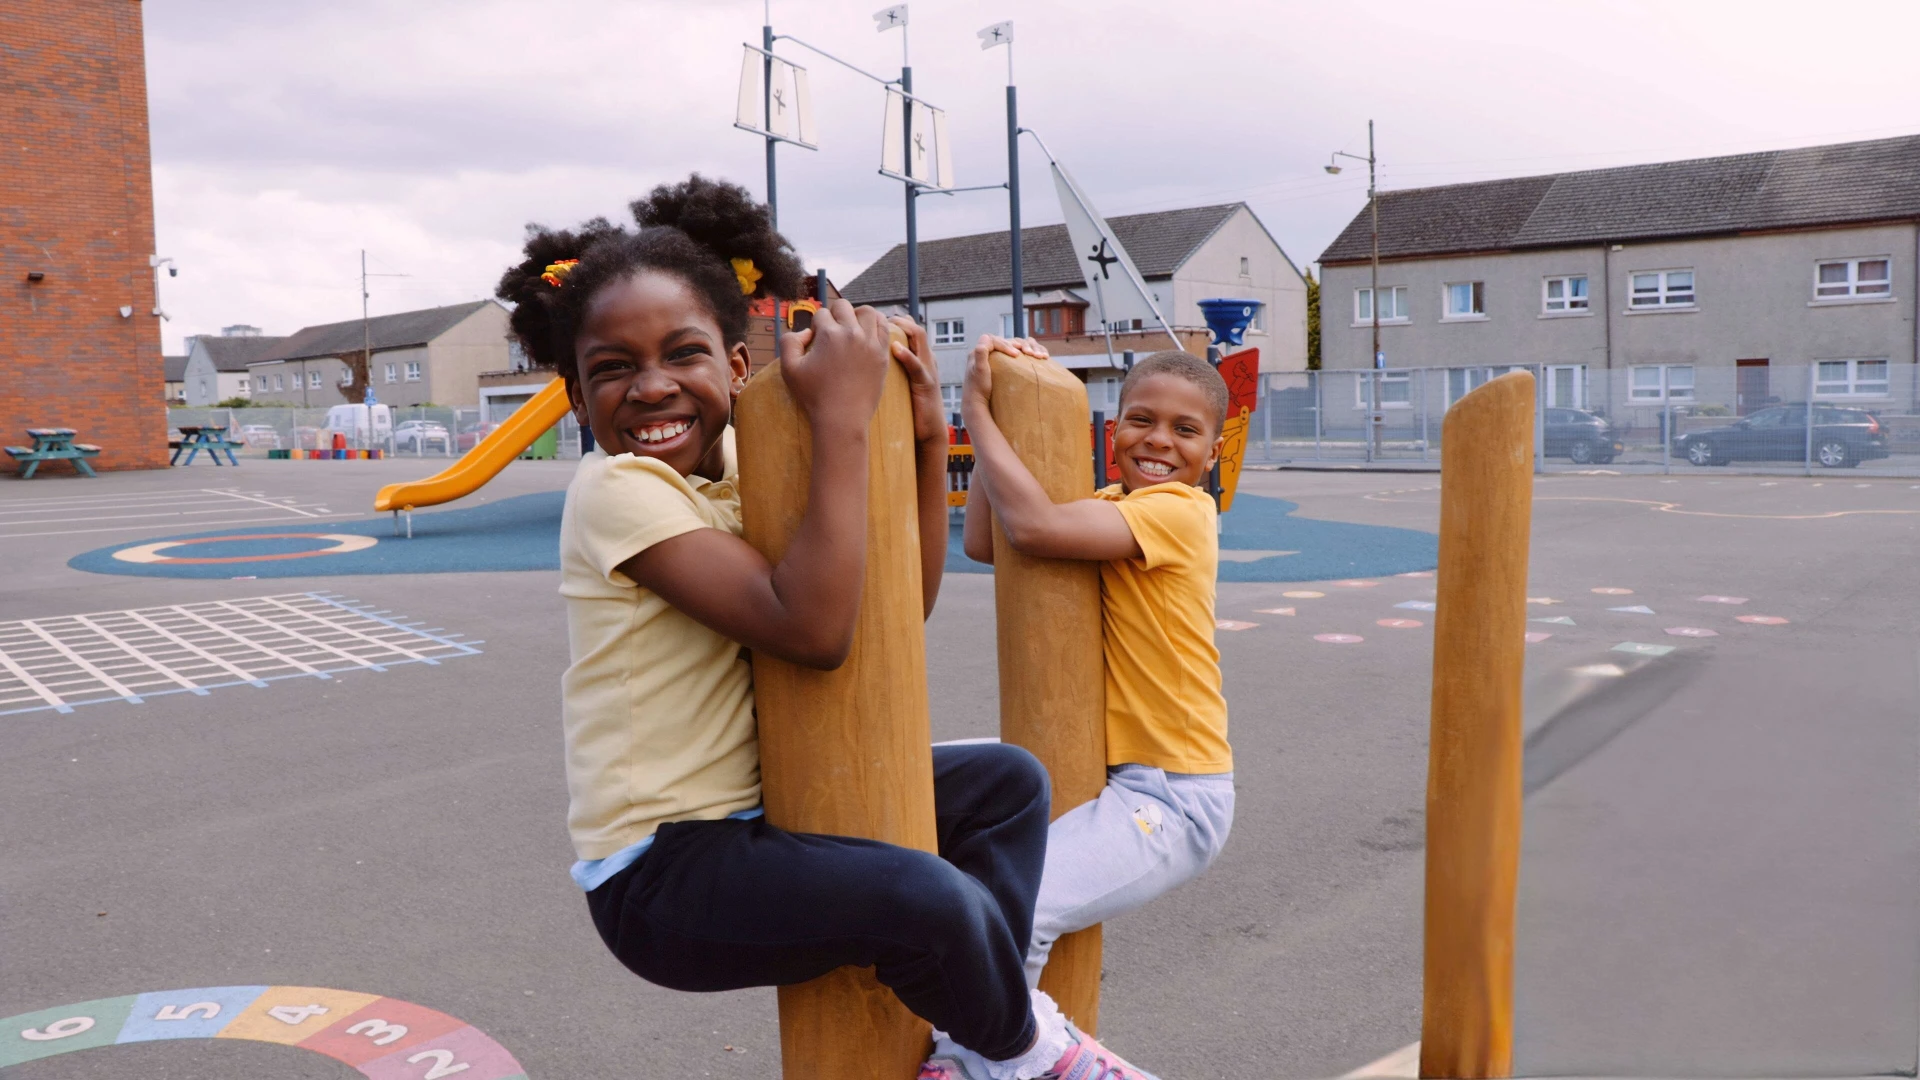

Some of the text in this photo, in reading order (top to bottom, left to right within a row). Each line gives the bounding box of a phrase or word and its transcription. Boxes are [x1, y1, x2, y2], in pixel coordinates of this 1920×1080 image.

[155, 1002, 222, 1021] 5
[268, 1004, 329, 1026] 4
[21, 1016, 95, 1041] 6
[345, 1018, 409, 1047] 3
[406, 1049, 471, 1080] 2
[1064, 1048, 1091, 1080] KECHERS
